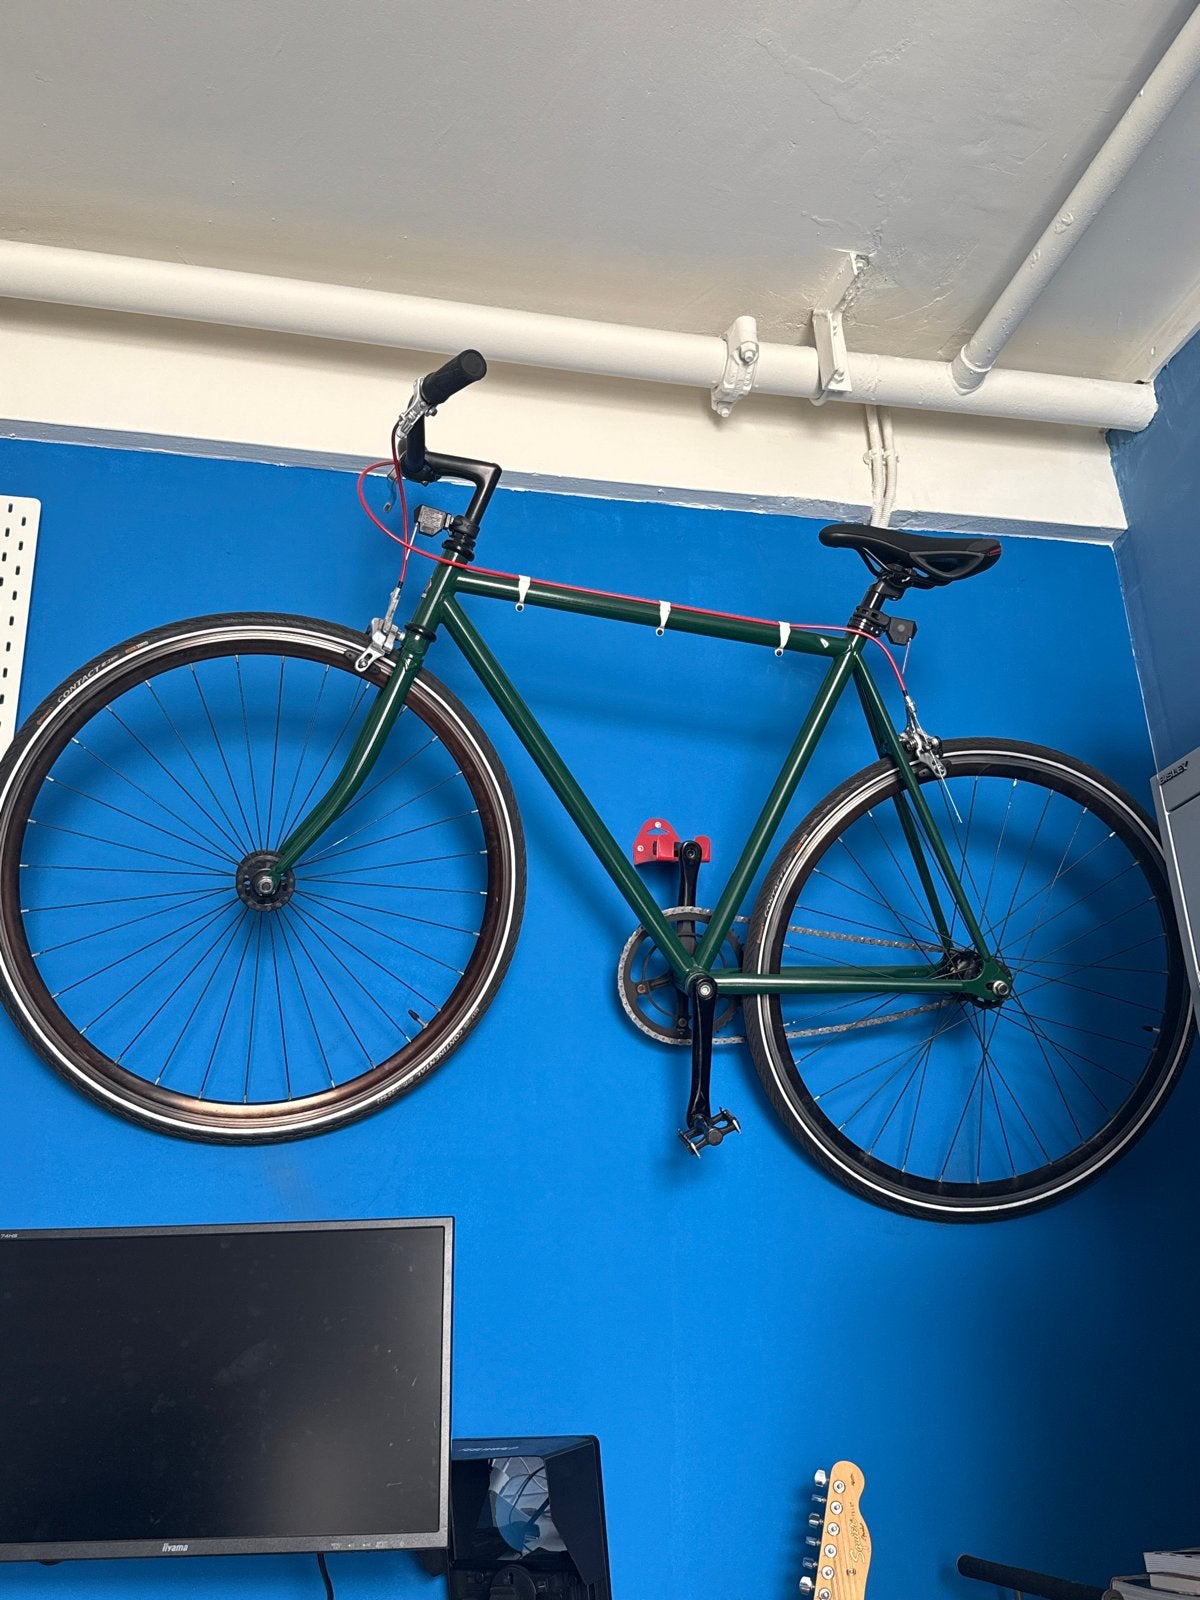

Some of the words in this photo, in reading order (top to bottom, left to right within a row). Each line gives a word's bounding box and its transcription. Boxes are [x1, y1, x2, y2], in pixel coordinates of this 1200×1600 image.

[57, 664, 101, 703] CONTACT
[1159, 760, 1189, 786] BISLEY
[416, 1029, 463, 1077] CONTINENTAL
[162, 1542, 189, 1552] iiyama
